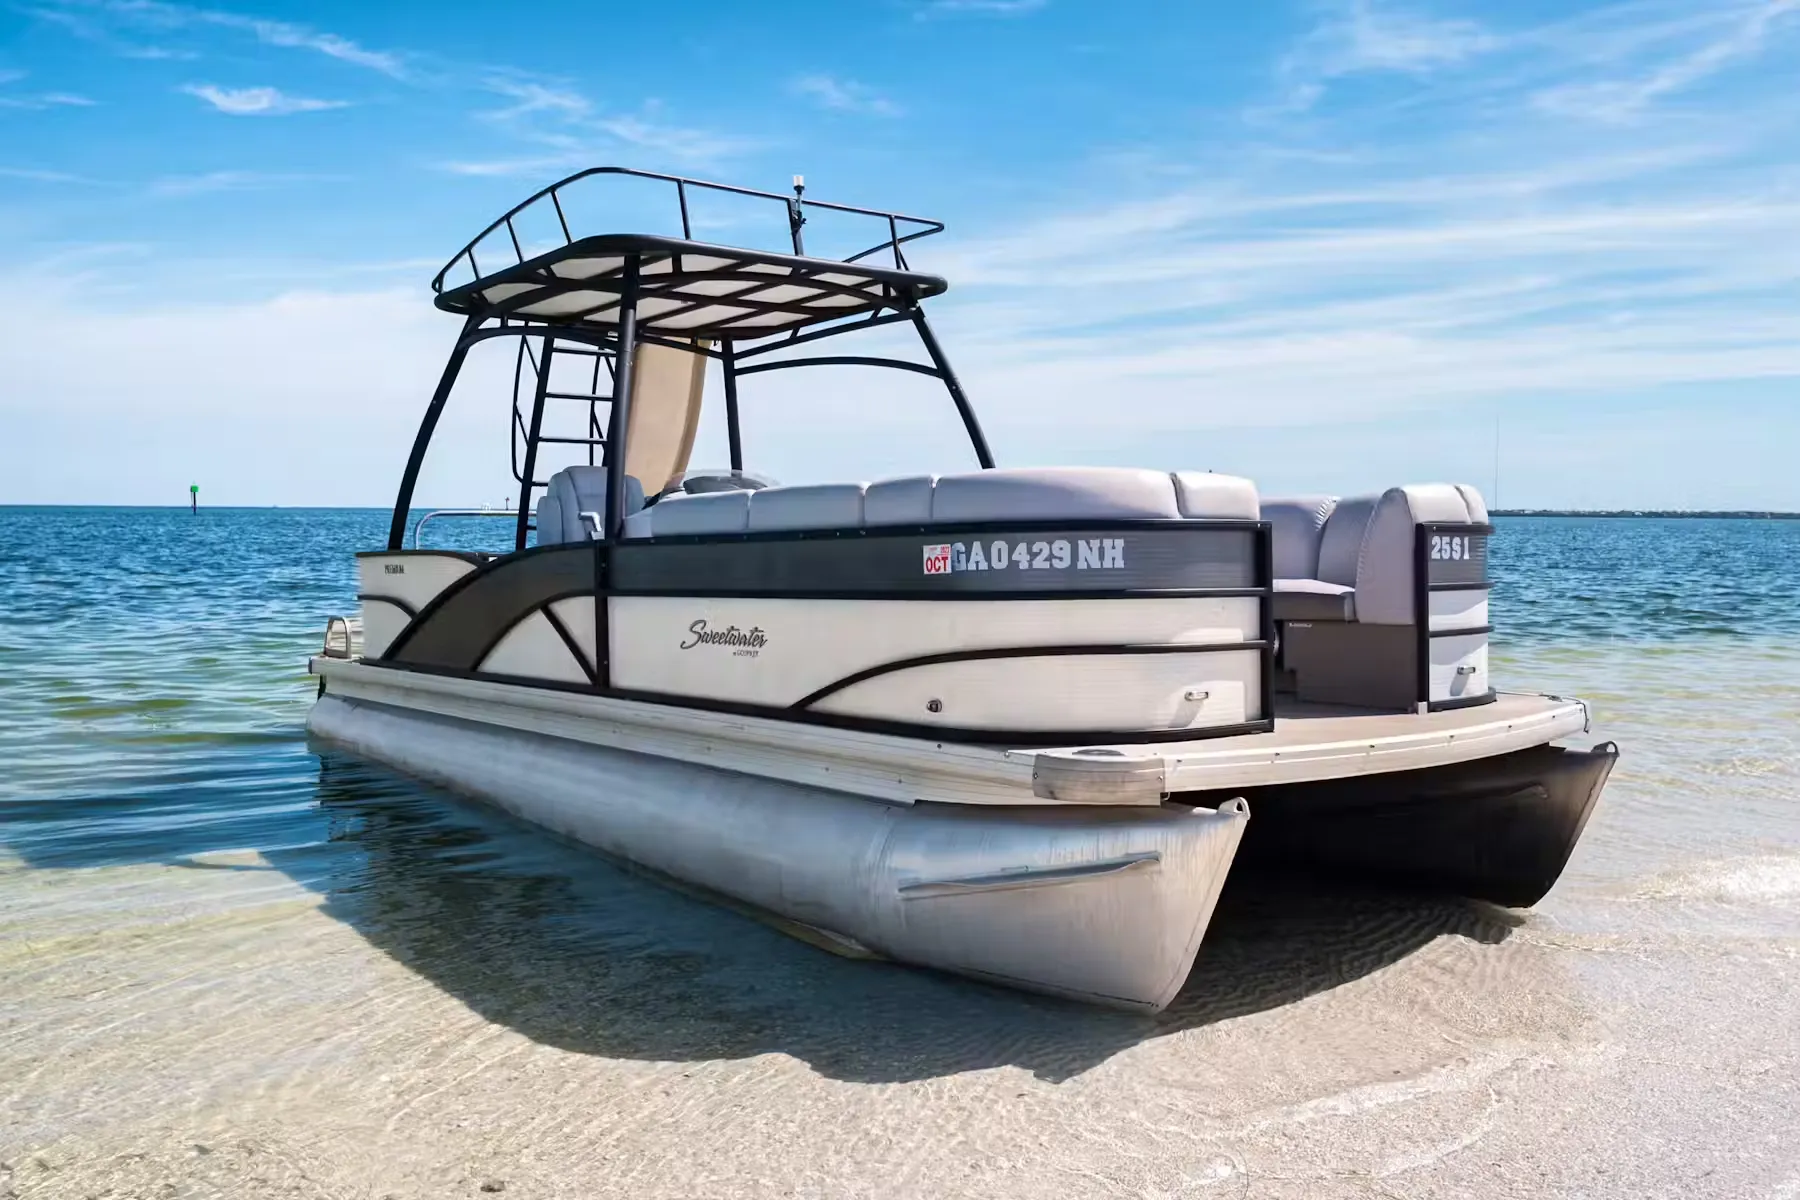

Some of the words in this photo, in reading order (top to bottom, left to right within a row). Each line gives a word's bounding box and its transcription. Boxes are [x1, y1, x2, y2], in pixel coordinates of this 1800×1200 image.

[925, 556, 949, 573] OCT
[1076, 538, 1125, 570] NH
[680, 619, 768, 650] Sweetwater
